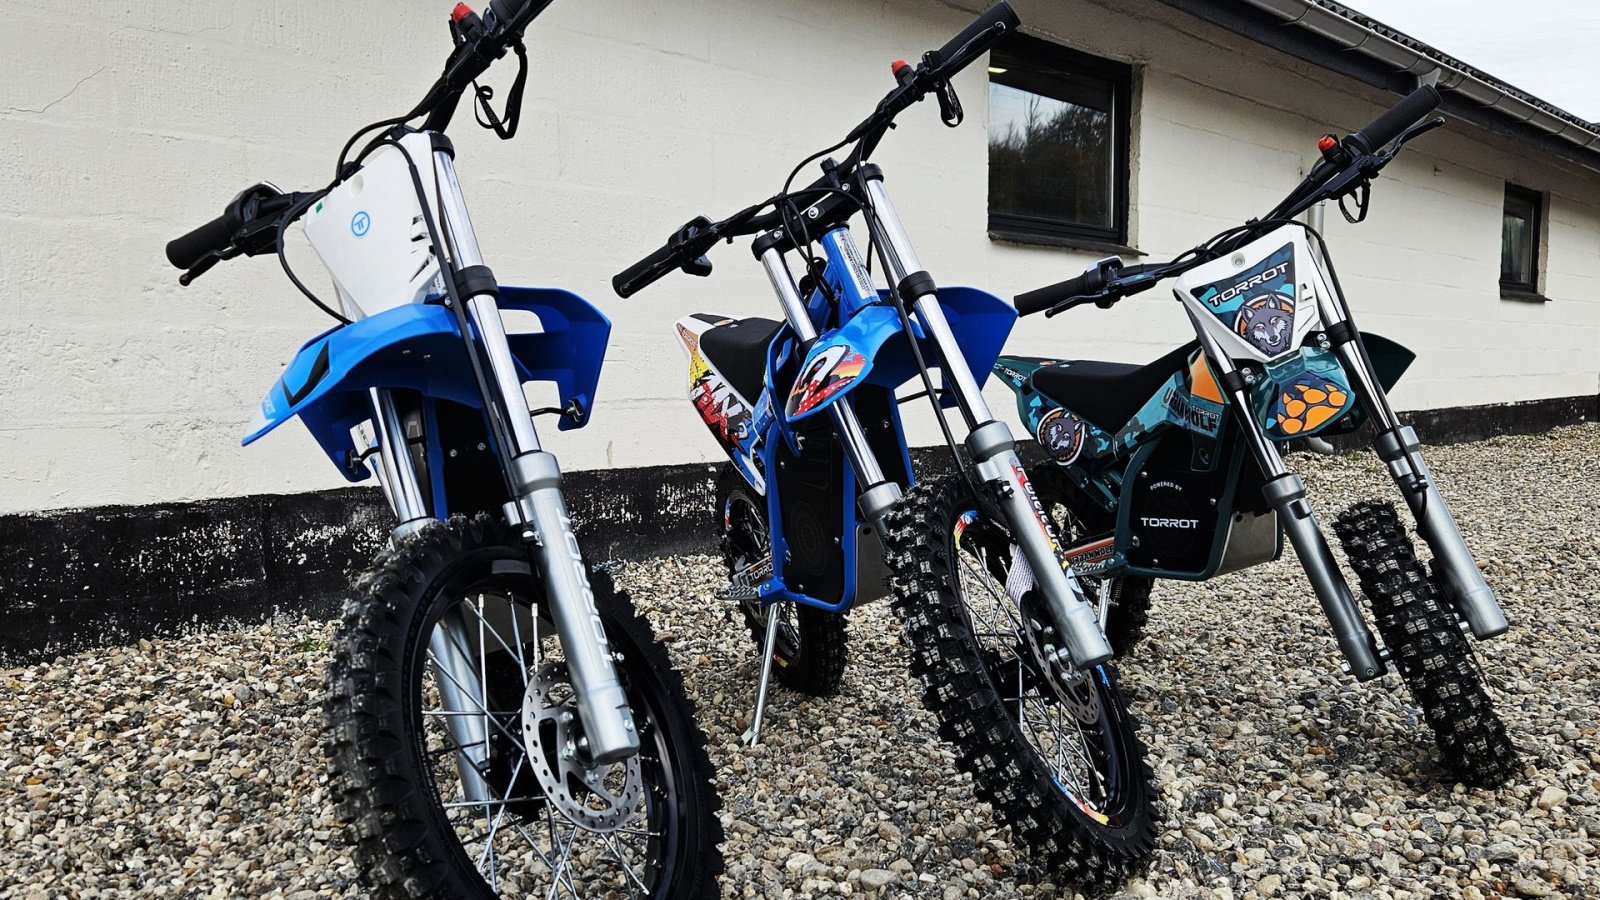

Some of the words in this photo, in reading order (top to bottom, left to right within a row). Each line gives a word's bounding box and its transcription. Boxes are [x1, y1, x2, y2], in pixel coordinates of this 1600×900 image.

[1209, 262, 1288, 306] TORROT
[1140, 517, 1199, 529] TORROT
[748, 562, 774, 581] TORRO
[556, 507, 614, 669] TORROT
